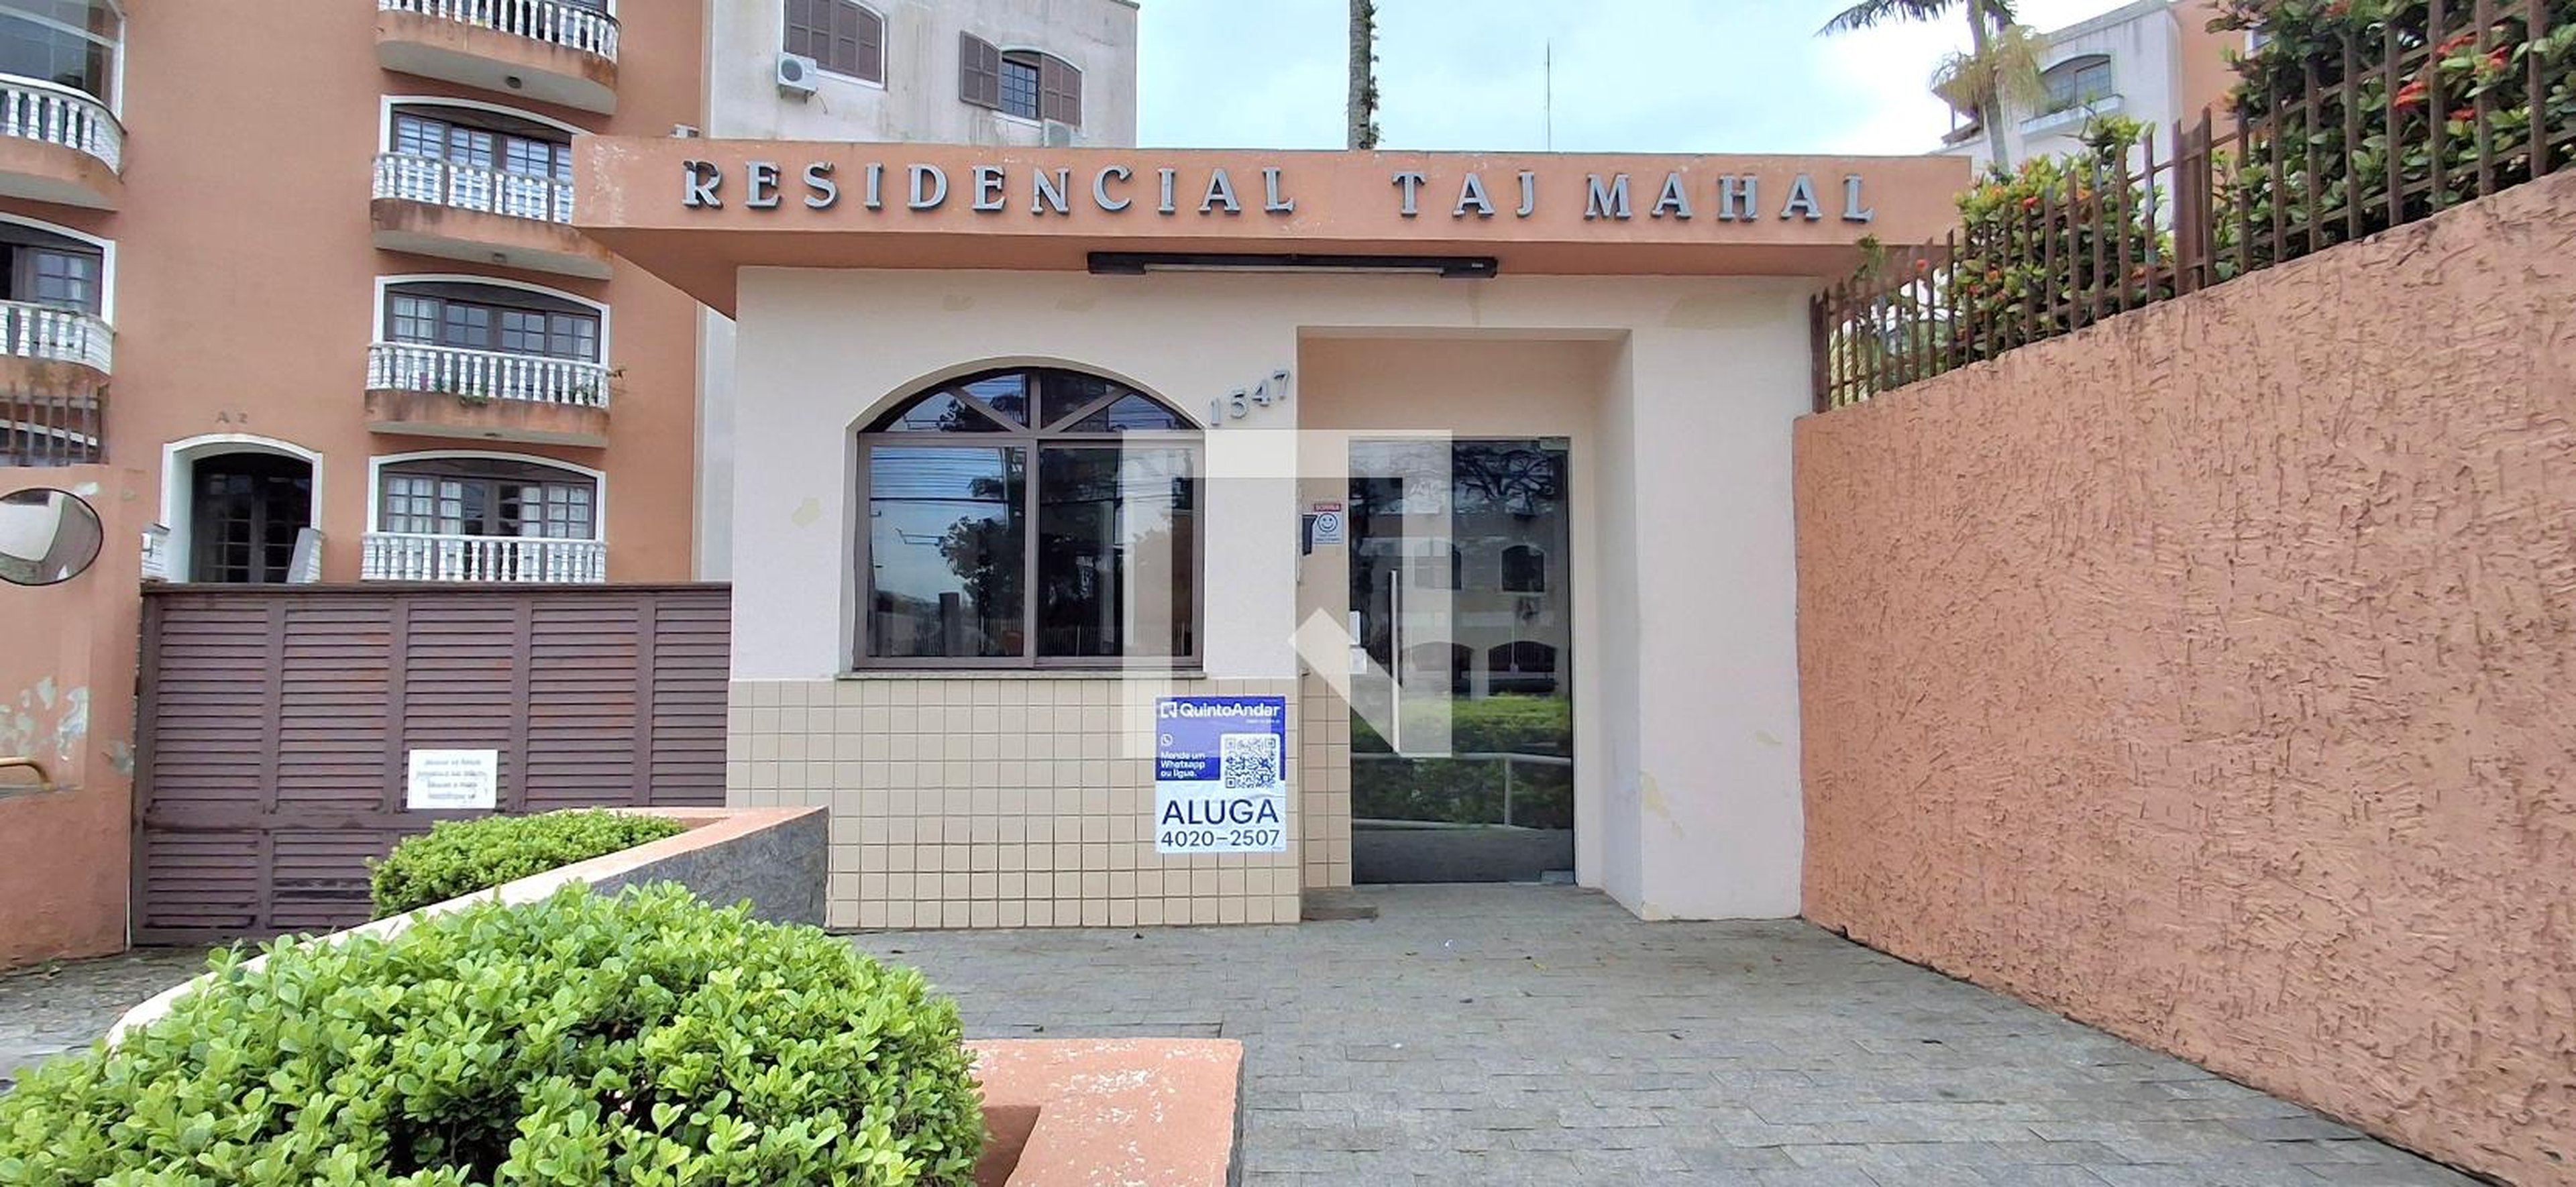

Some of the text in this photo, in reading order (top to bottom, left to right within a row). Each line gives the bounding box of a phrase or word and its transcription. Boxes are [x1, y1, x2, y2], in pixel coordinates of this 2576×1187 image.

[682, 160, 1874, 223] RESIDENCIAL TAJ MAHAL
[1210, 369, 1290, 426] 1547
[1179, 702, 1281, 717] QuintoAndar
[1161, 799, 1279, 825] ALUGA
[1161, 830, 1280, 847] 4020-2507
